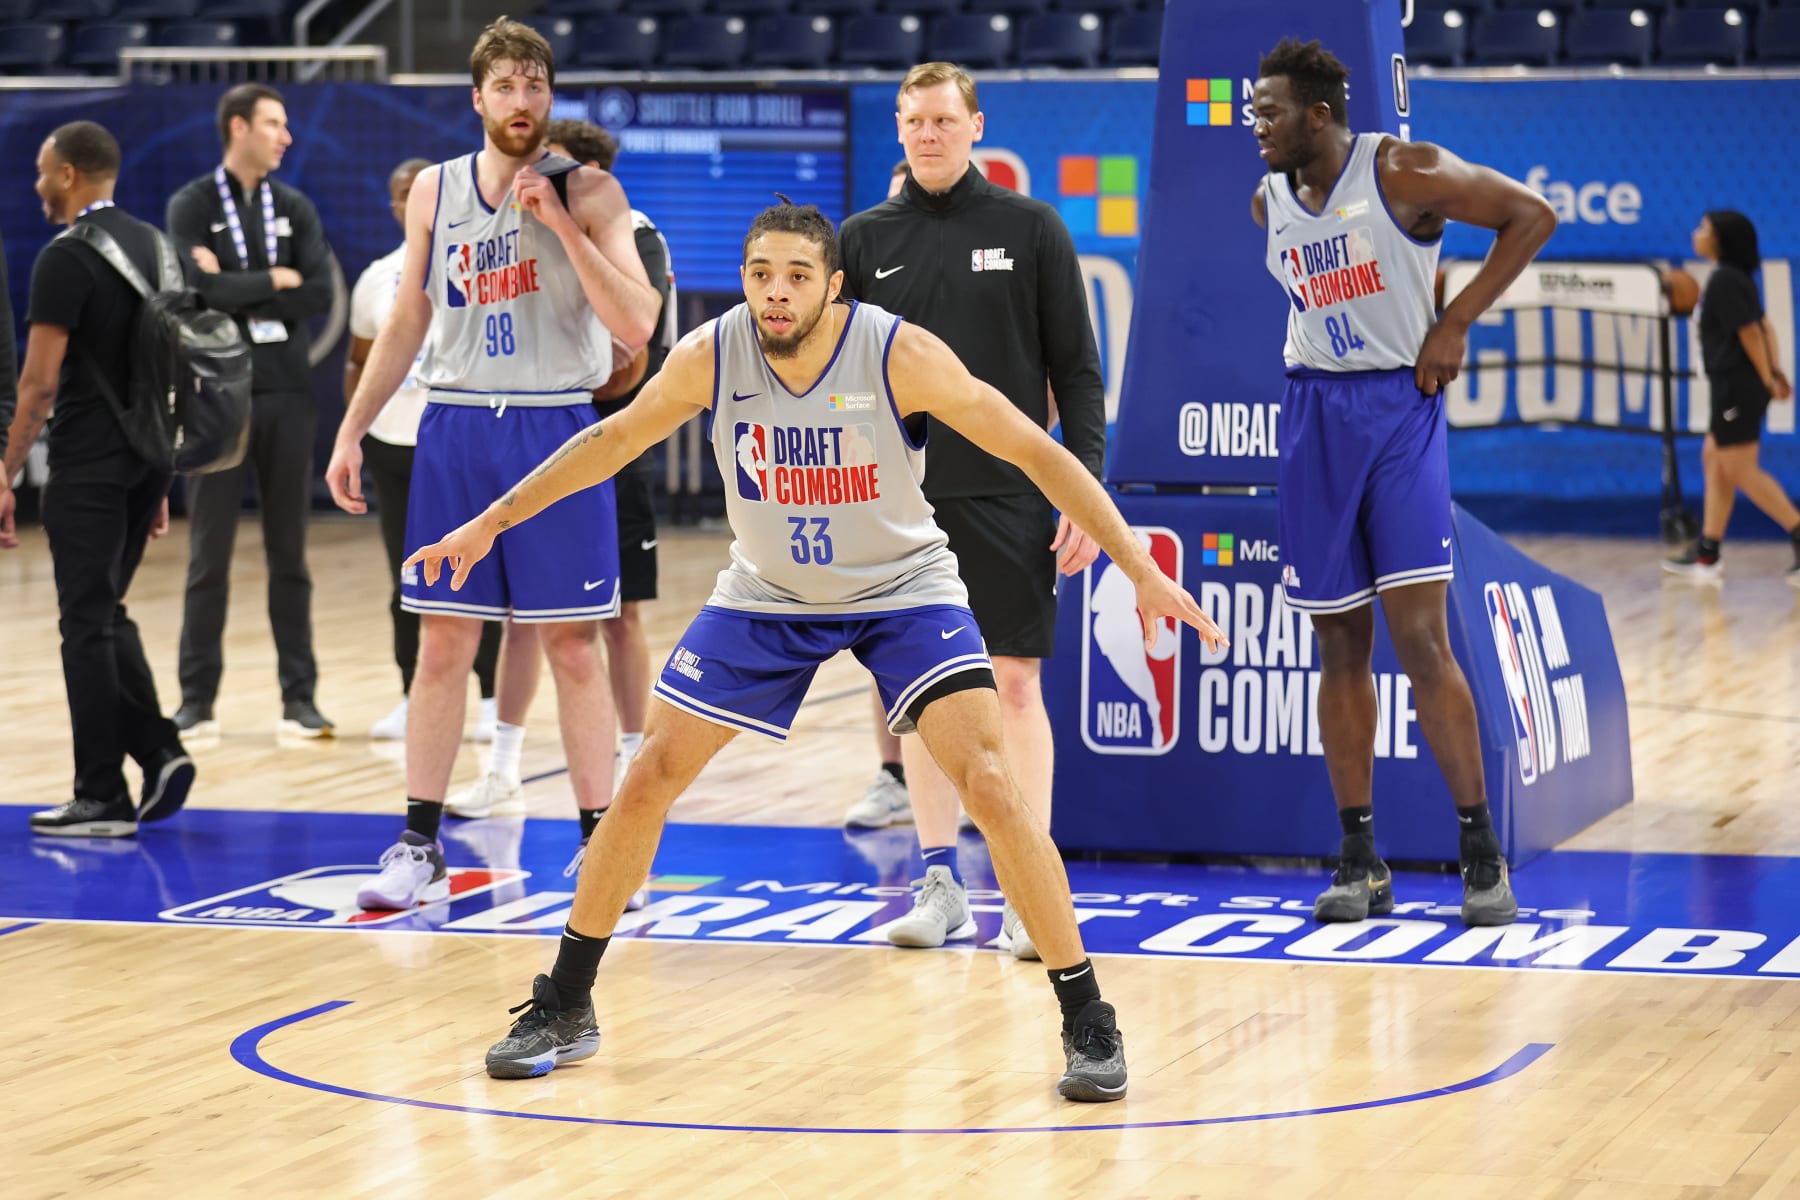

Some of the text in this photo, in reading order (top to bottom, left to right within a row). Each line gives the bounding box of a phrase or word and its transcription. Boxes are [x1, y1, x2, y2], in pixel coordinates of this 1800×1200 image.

[475, 229, 520, 272] DRAFT
[1302, 233, 1350, 276] DRAFT
[477, 258, 540, 305] COMBINE
[1309, 259, 1386, 310] COMBINE
[486, 312, 516, 357] 98
[1325, 312, 1365, 358] 84
[773, 426, 843, 466] DRAFT
[775, 463, 881, 506] COMBINE
[787, 516, 833, 566] 33
[681, 649, 702, 668] DRAFT
[1097, 701, 1142, 739] NBA
[196, 905, 314, 921] NBA
